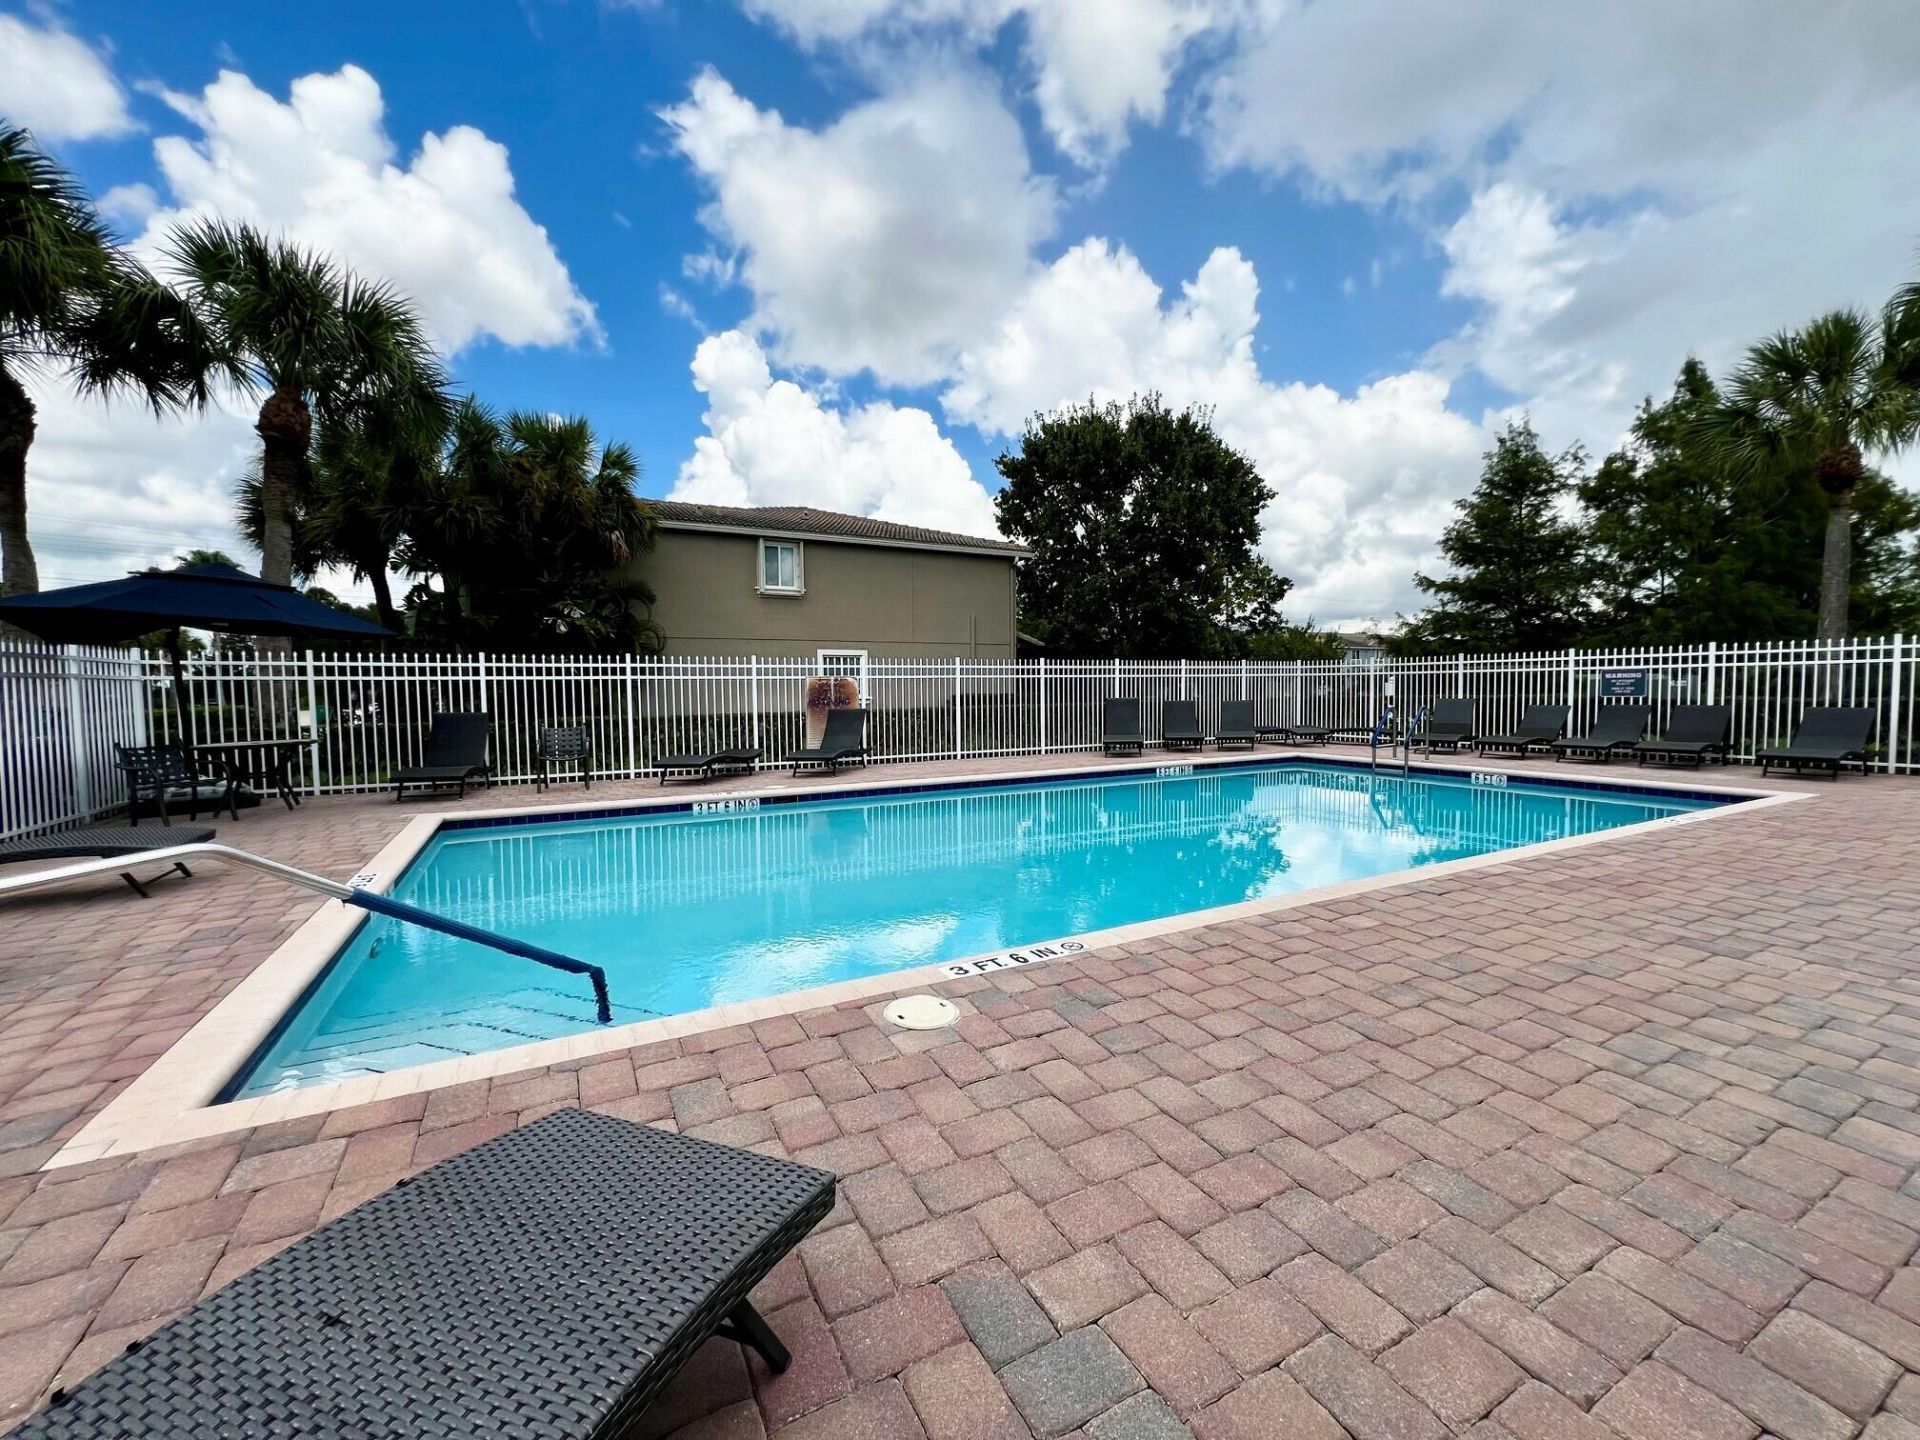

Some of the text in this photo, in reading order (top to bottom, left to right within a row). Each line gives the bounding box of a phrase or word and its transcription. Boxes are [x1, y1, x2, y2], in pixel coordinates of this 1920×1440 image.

[949, 947, 1064, 976] 3 FT. 6 IN.
